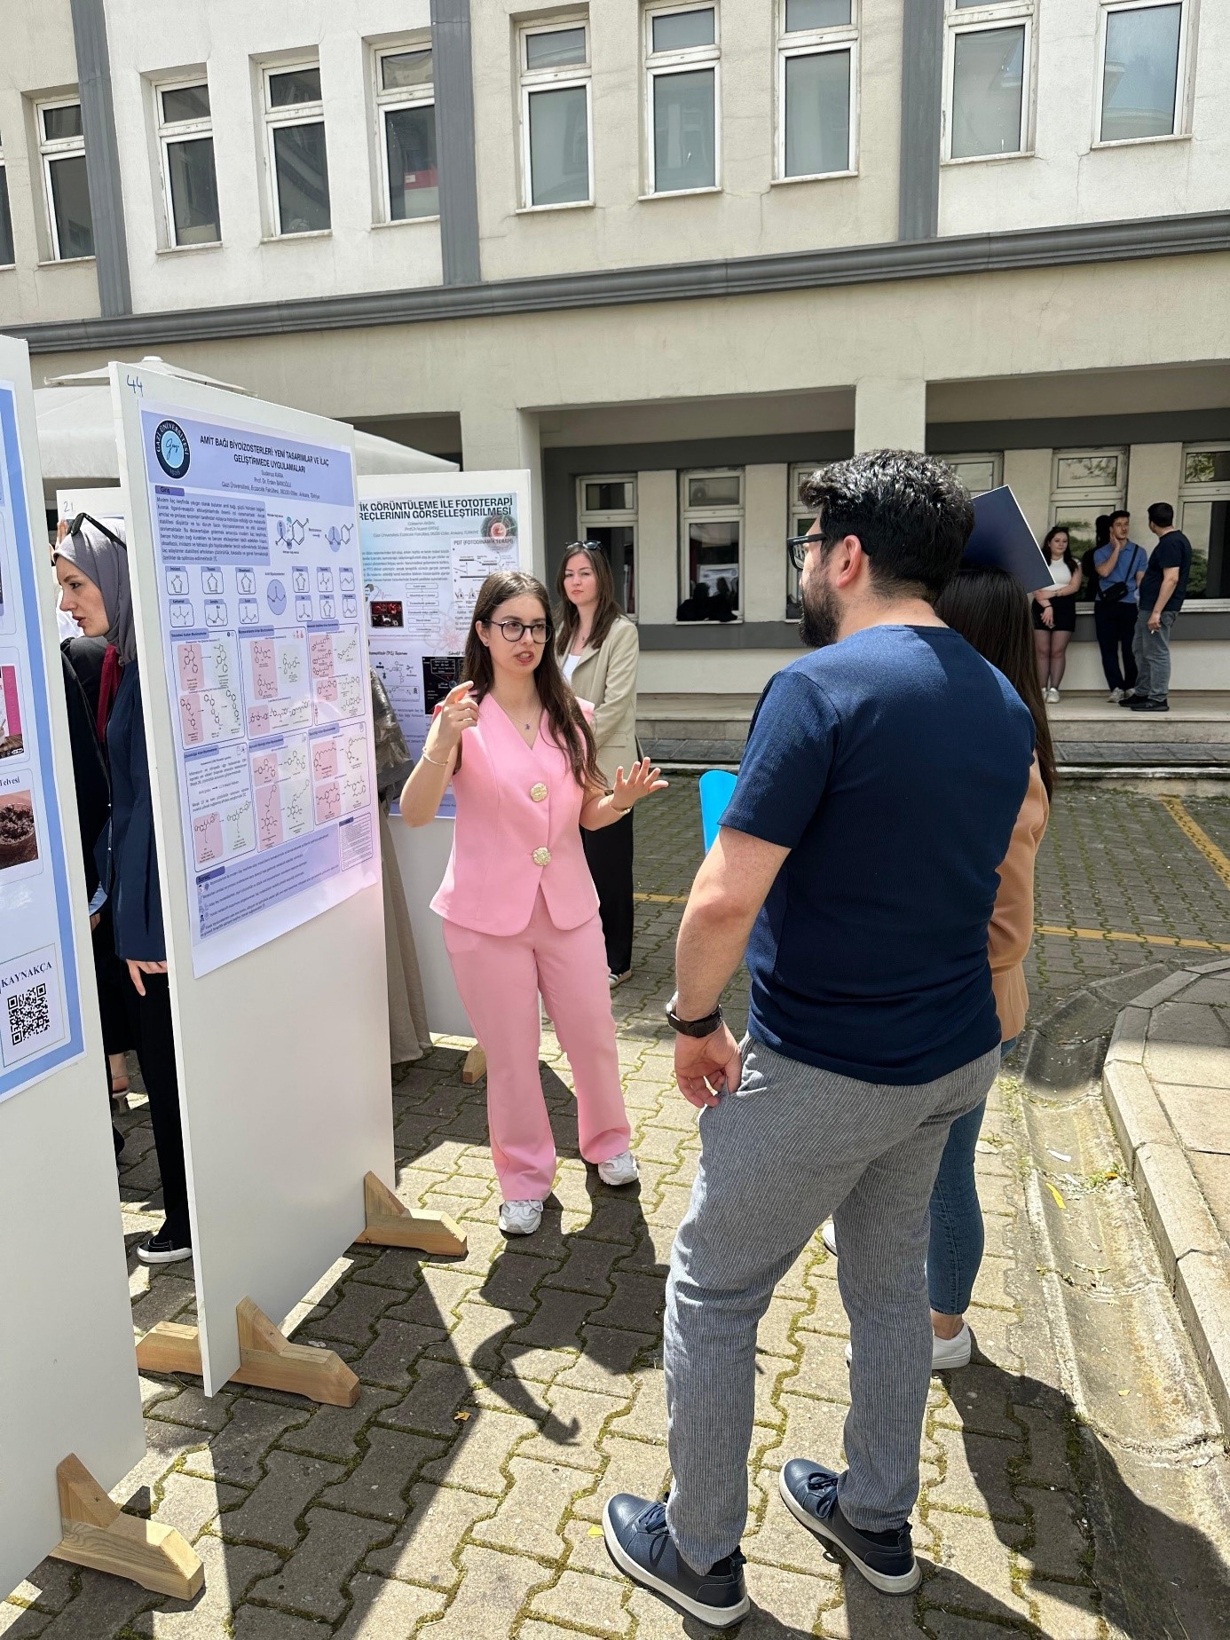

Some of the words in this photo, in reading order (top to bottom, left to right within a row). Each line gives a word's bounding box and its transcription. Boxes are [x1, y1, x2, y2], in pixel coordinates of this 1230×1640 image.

[127, 374, 144, 398] 44
[200, 435, 214, 446] AMİT
[215, 437, 229, 448] BAĞI
[274, 448, 286, 459] YENİ
[286, 450, 313, 463] TASARIMLAR
[313, 456, 320, 465] VE
[320, 455, 330, 468] İLAÇ
[233, 453, 271, 468] GELİŞTİRMEDE
[270, 459, 306, 474] UYGULAMALARI
[359, 501, 369, 512] İK
[370, 499, 438, 512] GÖRÜNTÜLEME
[440, 498, 454, 509] İLE
[455, 494, 513, 508] FOTOTERAPİ
[412, 505, 512, 519] GÖRSELLEŞTİRİLMESİ
[1, 961, 53, 988] KAYNAKÇA
